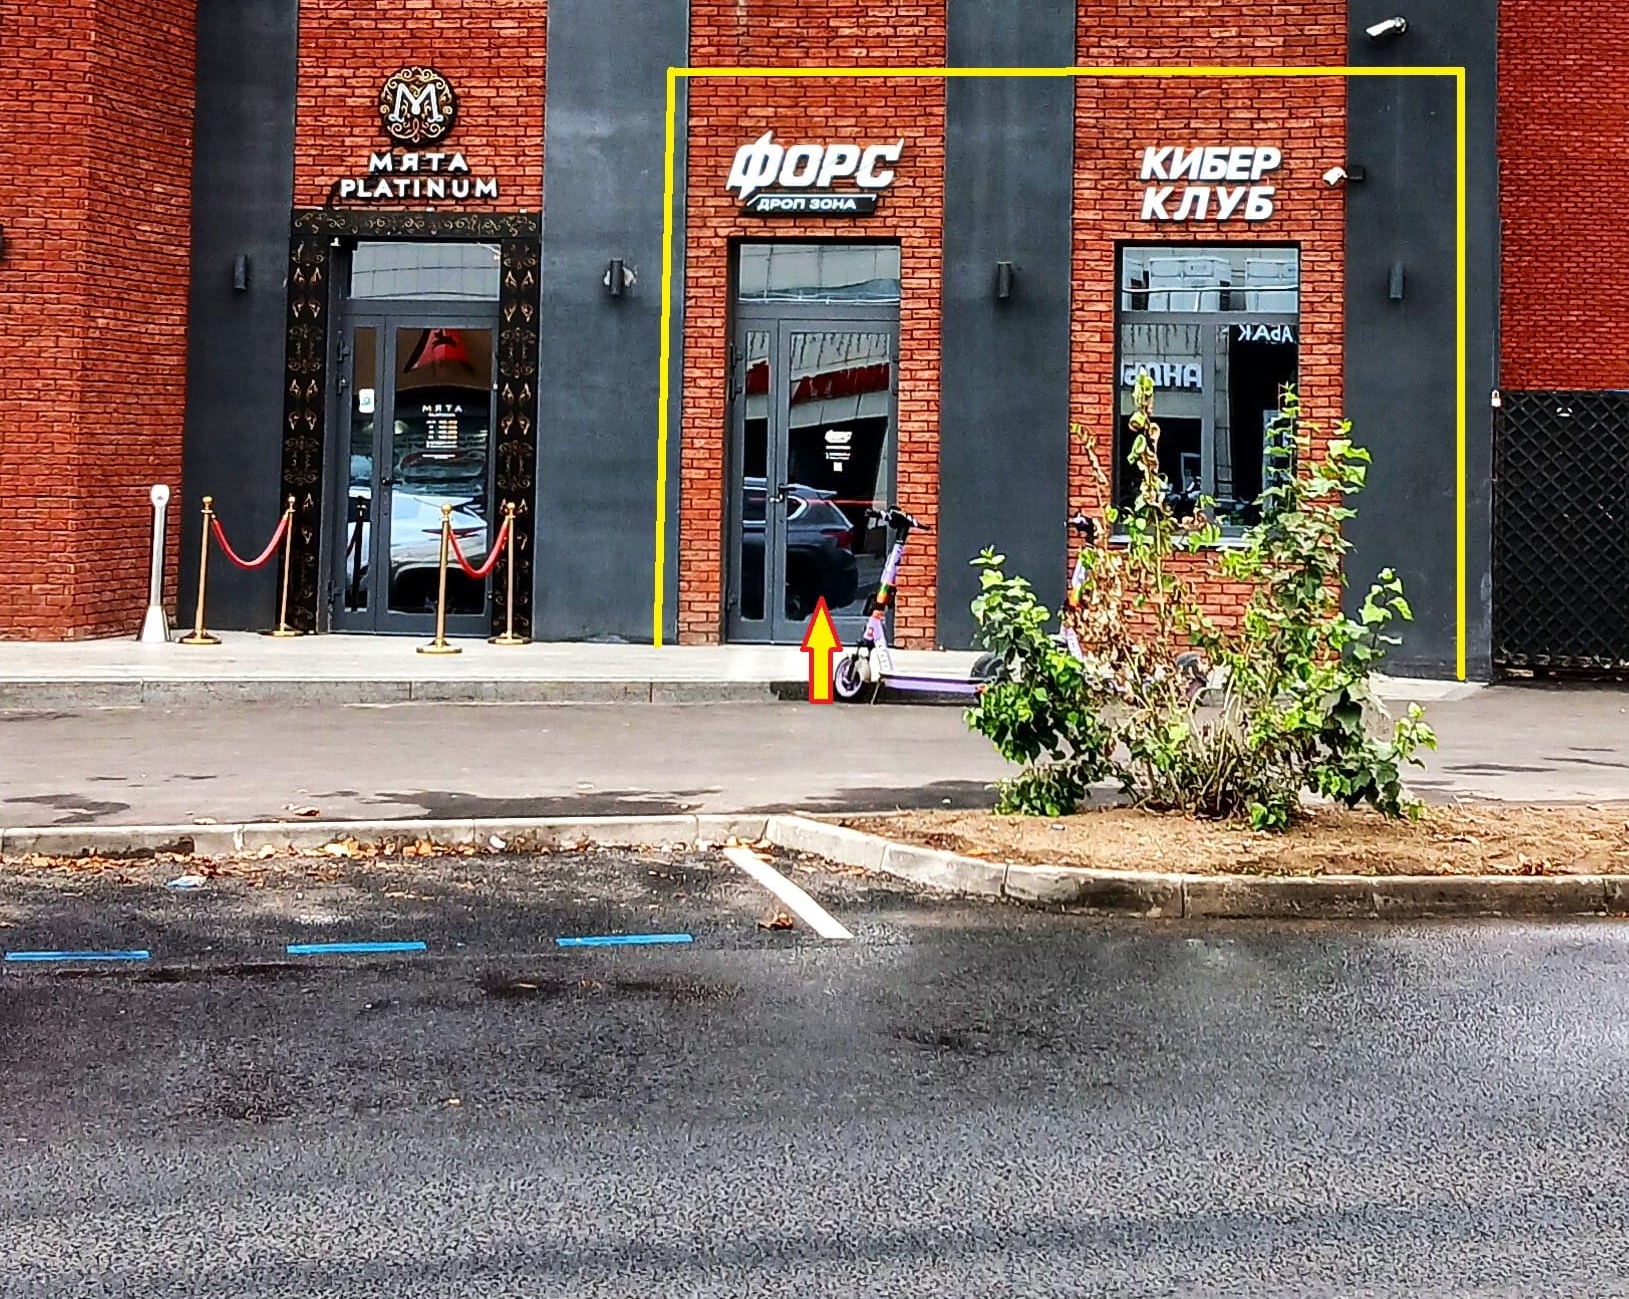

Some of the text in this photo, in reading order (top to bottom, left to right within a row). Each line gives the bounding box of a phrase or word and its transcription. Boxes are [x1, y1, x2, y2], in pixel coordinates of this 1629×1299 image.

[369, 153, 468, 172] МЯТА
[725, 130, 905, 200] ФОРС
[1140, 146, 1281, 180] КИБЕР
[340, 178, 497, 198] PLATINUM
[757, 198, 857, 211] ДРОП ЗОНА
[1141, 186, 1275, 220] КЛУБ
[422, 404, 463, 413] МЯТА
